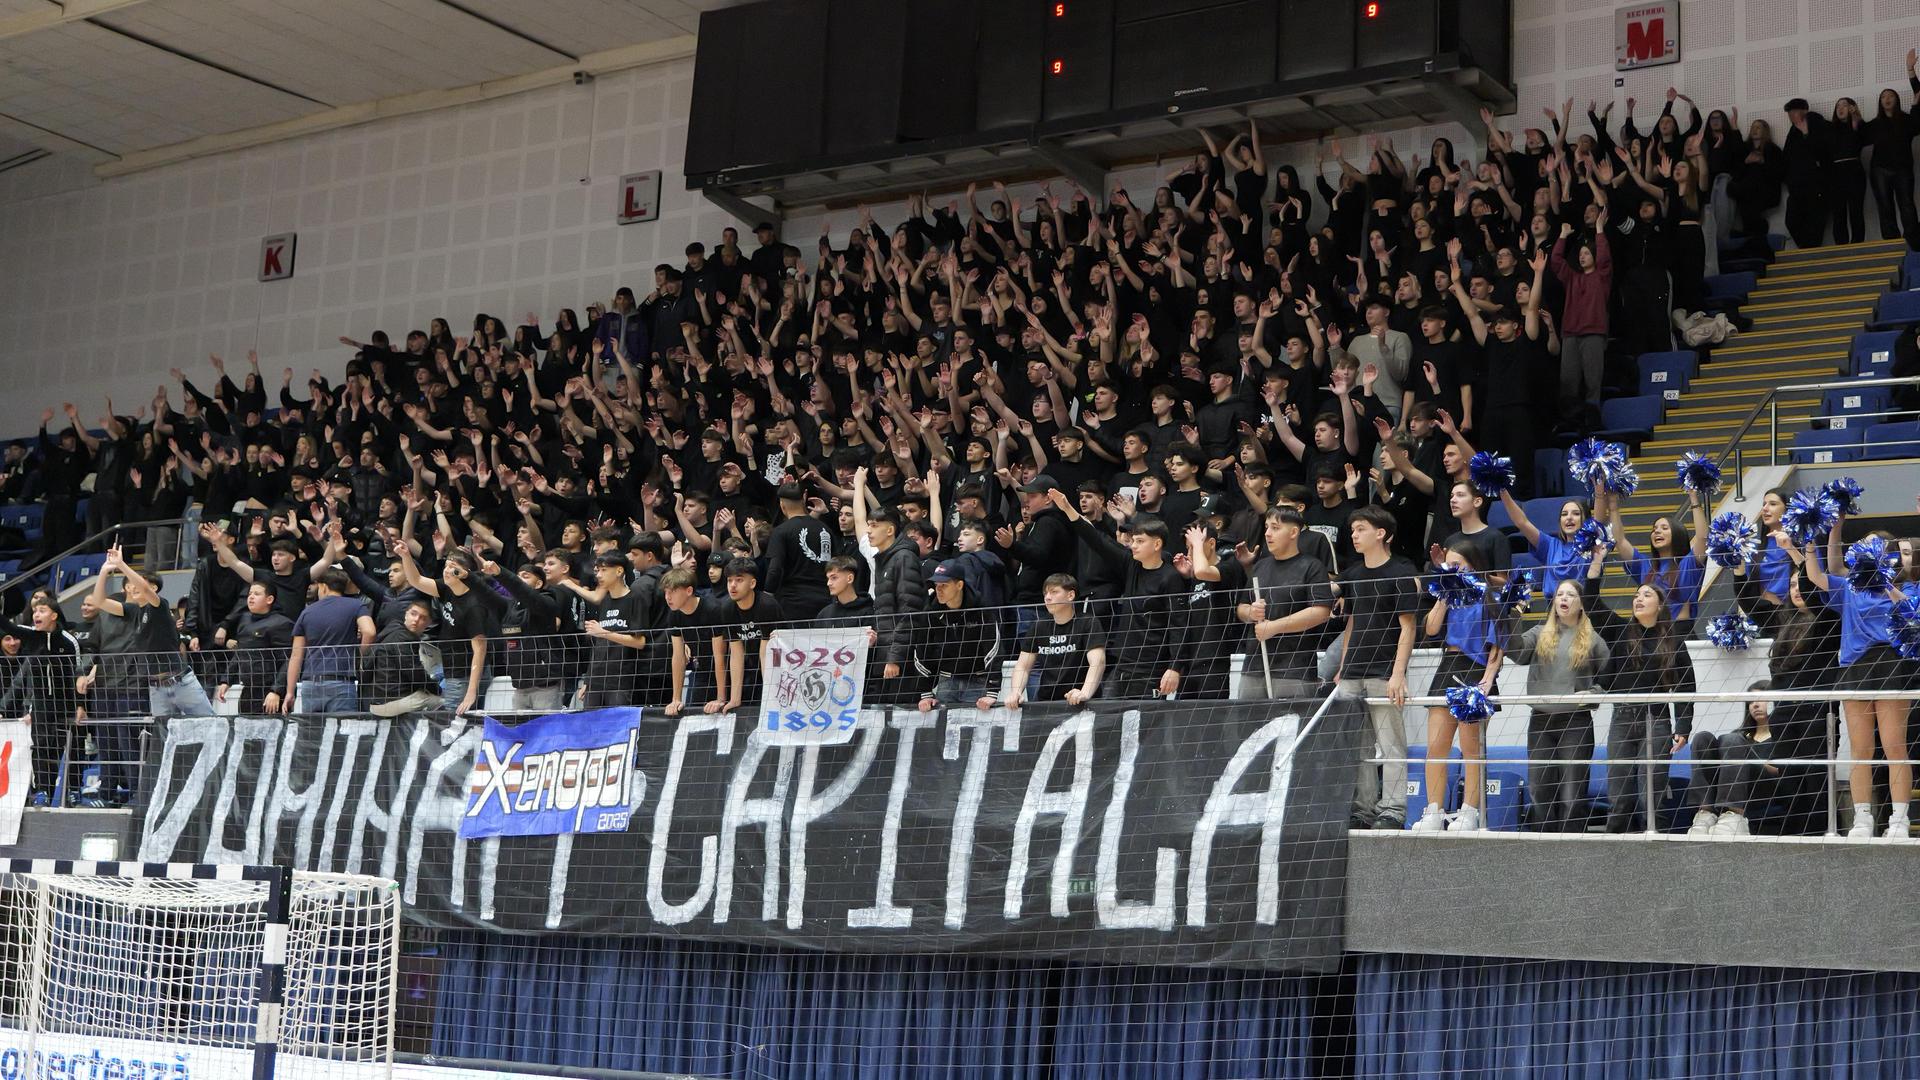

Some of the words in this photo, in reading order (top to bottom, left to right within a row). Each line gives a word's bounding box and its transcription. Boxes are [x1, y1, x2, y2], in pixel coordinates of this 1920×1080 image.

[1056, 4, 1064, 17] 5
[1368, 4, 1377, 17] 9
[1626, 18, 1665, 60] M
[1054, 61, 1062, 74] 9
[624, 186, 647, 218] L
[263, 245, 284, 276] K
[1832, 421, 1844, 429] R2
[1049, 635, 1067, 644] SUD
[770, 645, 856, 672] 1926
[767, 708, 858, 735] 1895
[466, 727, 639, 833] Xenopol
[1406, 785, 1415, 794] 9
[597, 811, 631, 831] 2025
[646, 707, 1300, 931] CAPITALA
